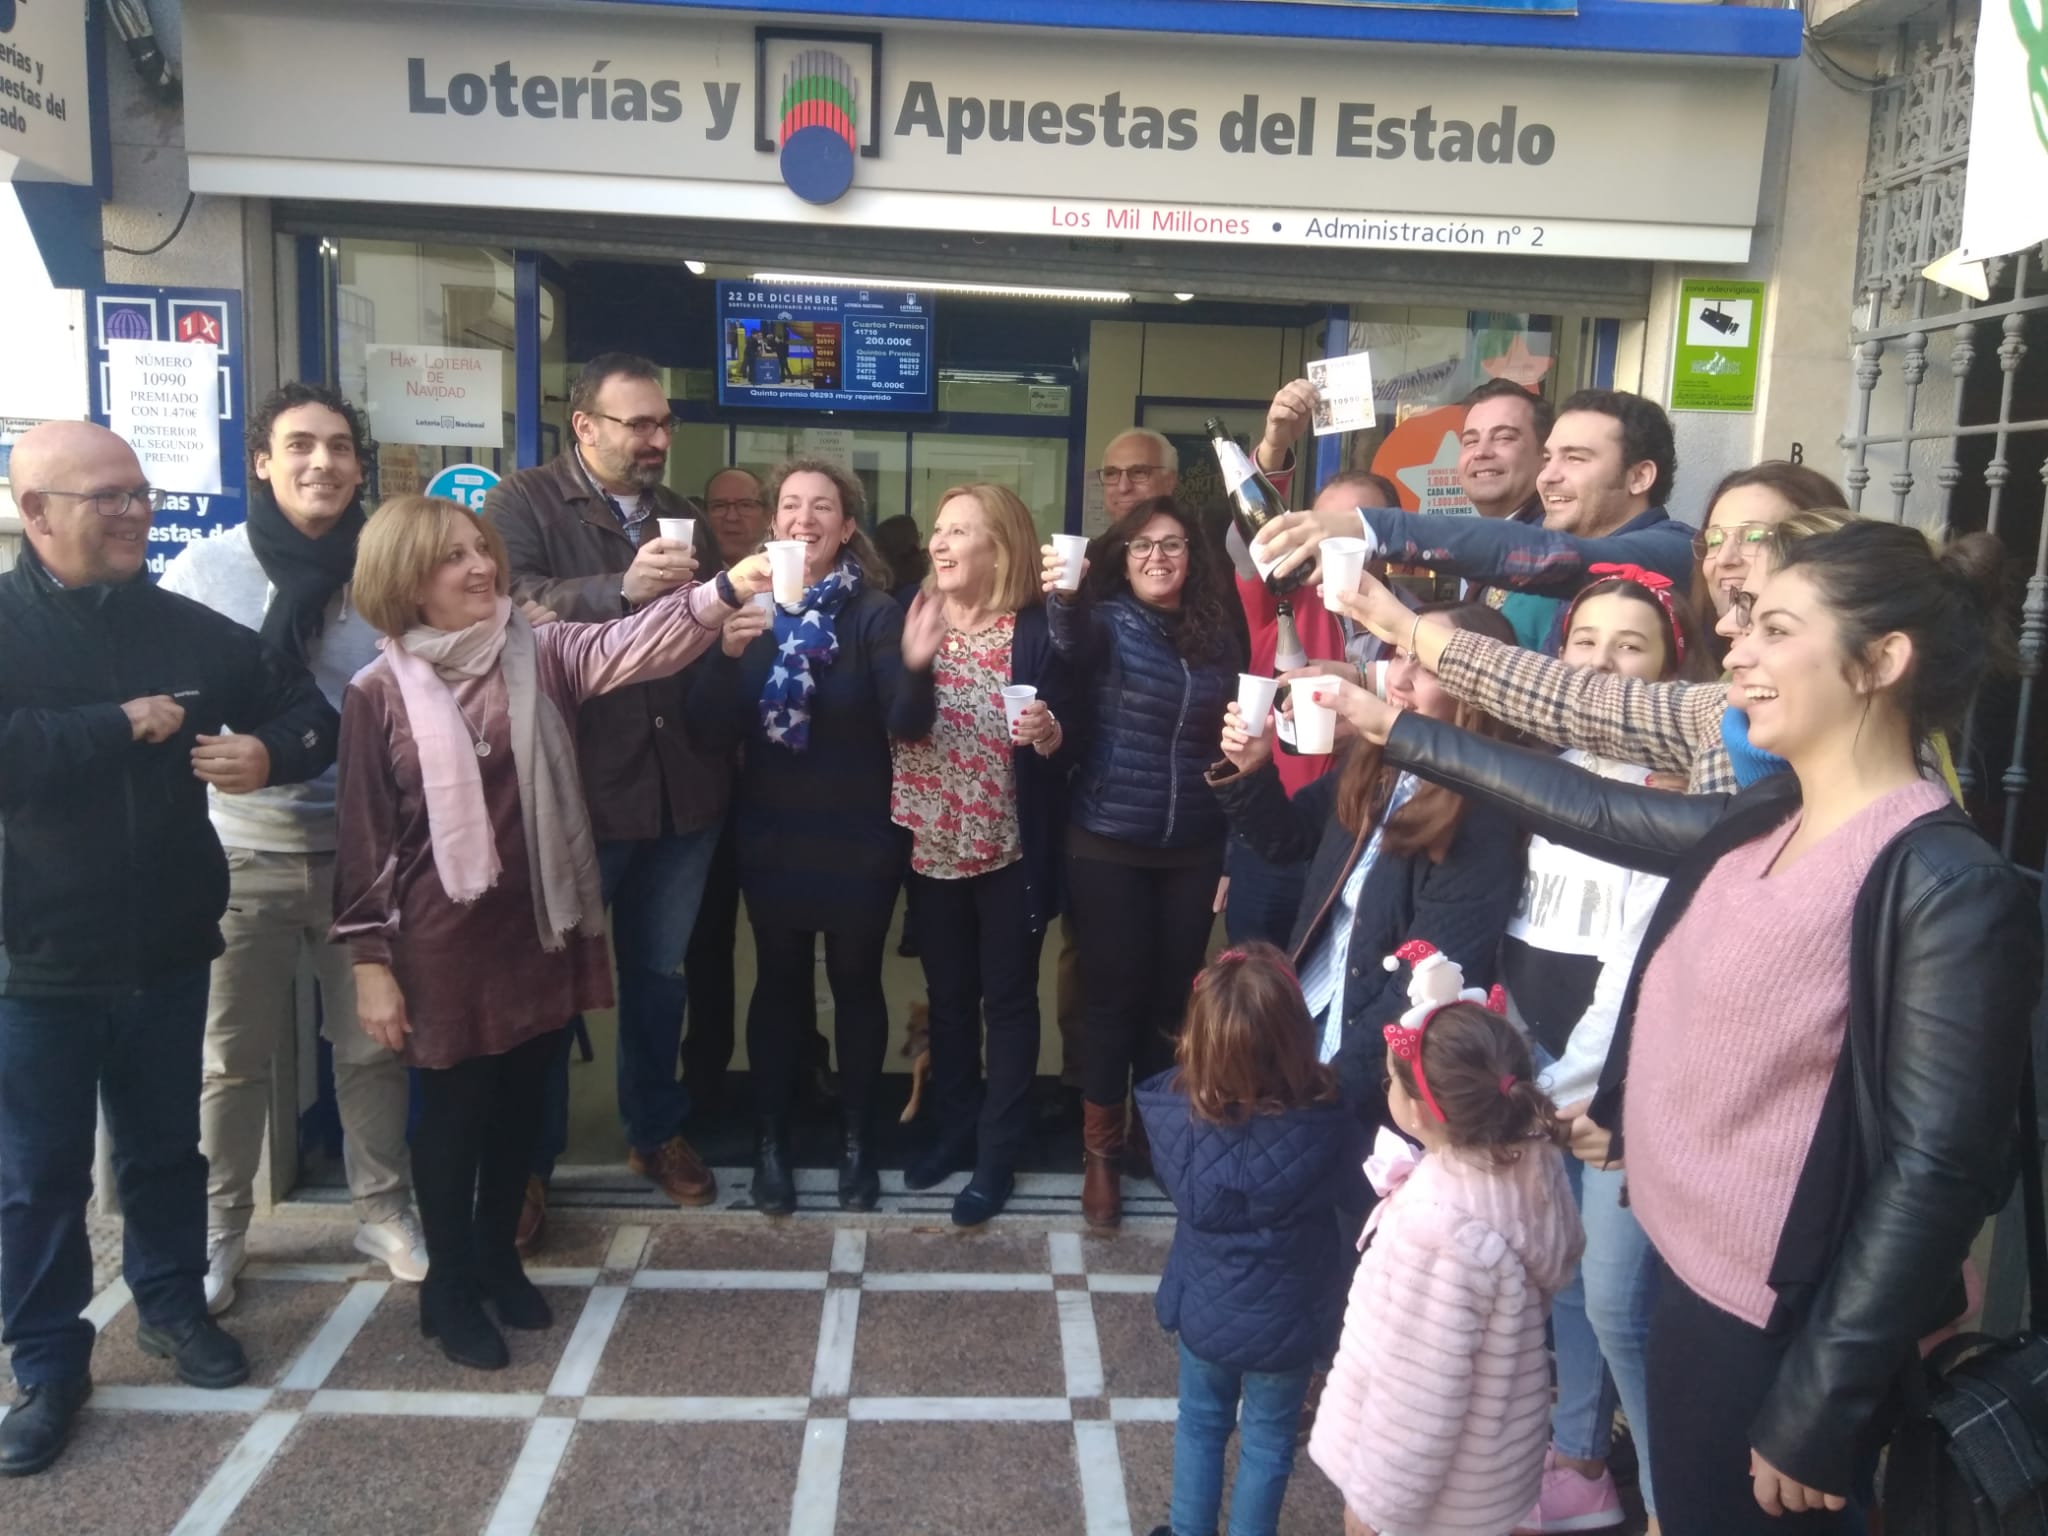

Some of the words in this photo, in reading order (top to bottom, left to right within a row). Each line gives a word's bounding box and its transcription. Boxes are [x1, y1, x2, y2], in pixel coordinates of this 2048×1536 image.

[36, 61, 44, 85] y
[46, 91, 66, 121] del
[407, 57, 683, 123] Loterías
[702, 81, 742, 141] y
[893, 80, 1199, 156] Apuestas
[1218, 93, 1317, 157] del
[1335, 102, 1556, 167] Estado
[1051, 205, 1091, 228] Los
[1106, 208, 1141, 231] Mil
[1152, 210, 1251, 235] Millones
[1304, 216, 1485, 245] Administración
[1530, 226, 1545, 247] 2
[728, 291, 743, 301] 22
[748, 292, 764, 302] DE
[769, 293, 838, 305] DICIEMBRE
[852, 320, 887, 329] Cuartos
[888, 321, 925, 330] Premios
[865, 336, 912, 346] 200.000€
[856, 349, 887, 357] Quintos
[888, 349, 921, 358] Premios
[134, 353, 193, 369] NÚMERO
[142, 372, 187, 388] 10990
[871, 381, 905, 389] 60.000€
[130, 390, 199, 404] PREMIADO
[750, 389, 778, 397] Quinto
[780, 391, 808, 399] premio
[835, 393, 852, 401] muy
[855, 393, 892, 401] repartido
[131, 406, 159, 417] CON
[163, 406, 198, 419] 1.470€
[133, 424, 198, 438] POSTERIOR
[455, 421, 485, 429] Nacional
[130, 439, 145, 449] AL
[147, 439, 204, 450] SEGUNDO
[145, 452, 189, 463] PREMIO
[1427, 488, 1444, 496] CADA
[195, 495, 210, 517] y
[1445, 507, 1473, 515] VIERNES
